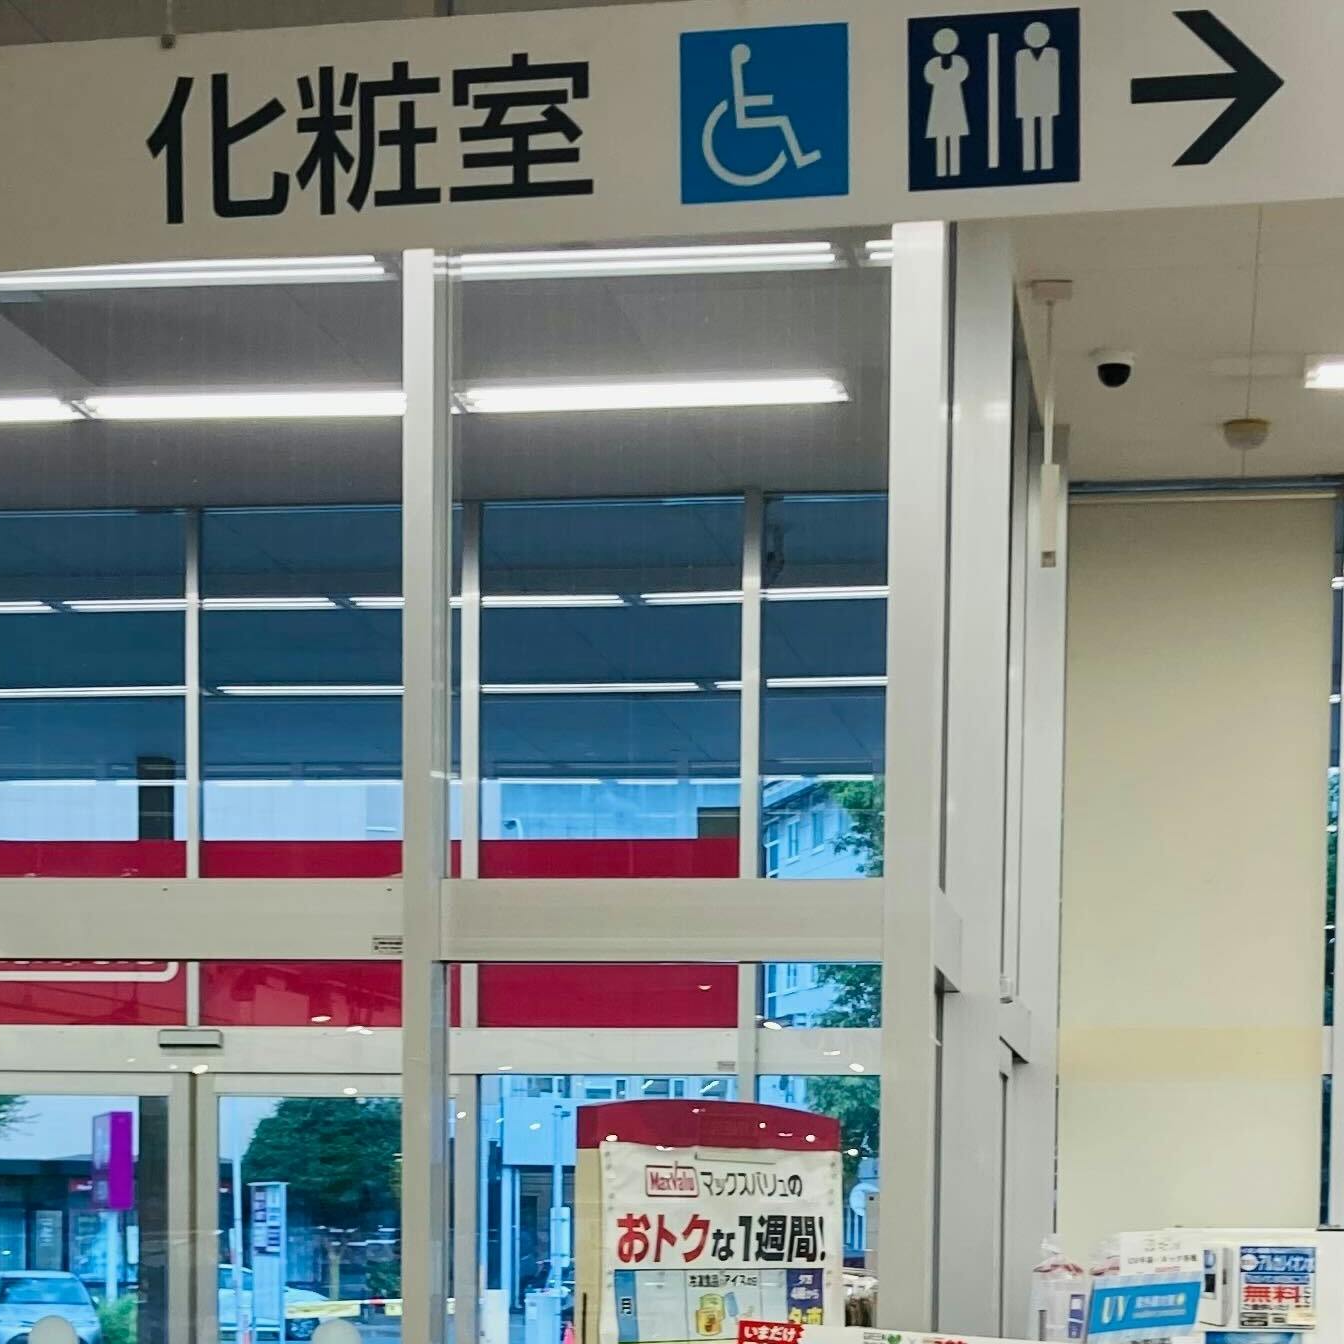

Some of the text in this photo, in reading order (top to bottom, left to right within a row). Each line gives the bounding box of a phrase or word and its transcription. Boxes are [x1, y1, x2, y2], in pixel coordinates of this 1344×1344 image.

[146, 52, 594, 226] 化粧室
[700, 1171, 803, 1197] マックスバリュの
[617, 1213, 826, 1263] おトクな1週間!
[1243, 1285, 1302, 1304] 無料
[621, 1297, 632, 1315] 月
[743, 1325, 797, 1343] いまだけ
